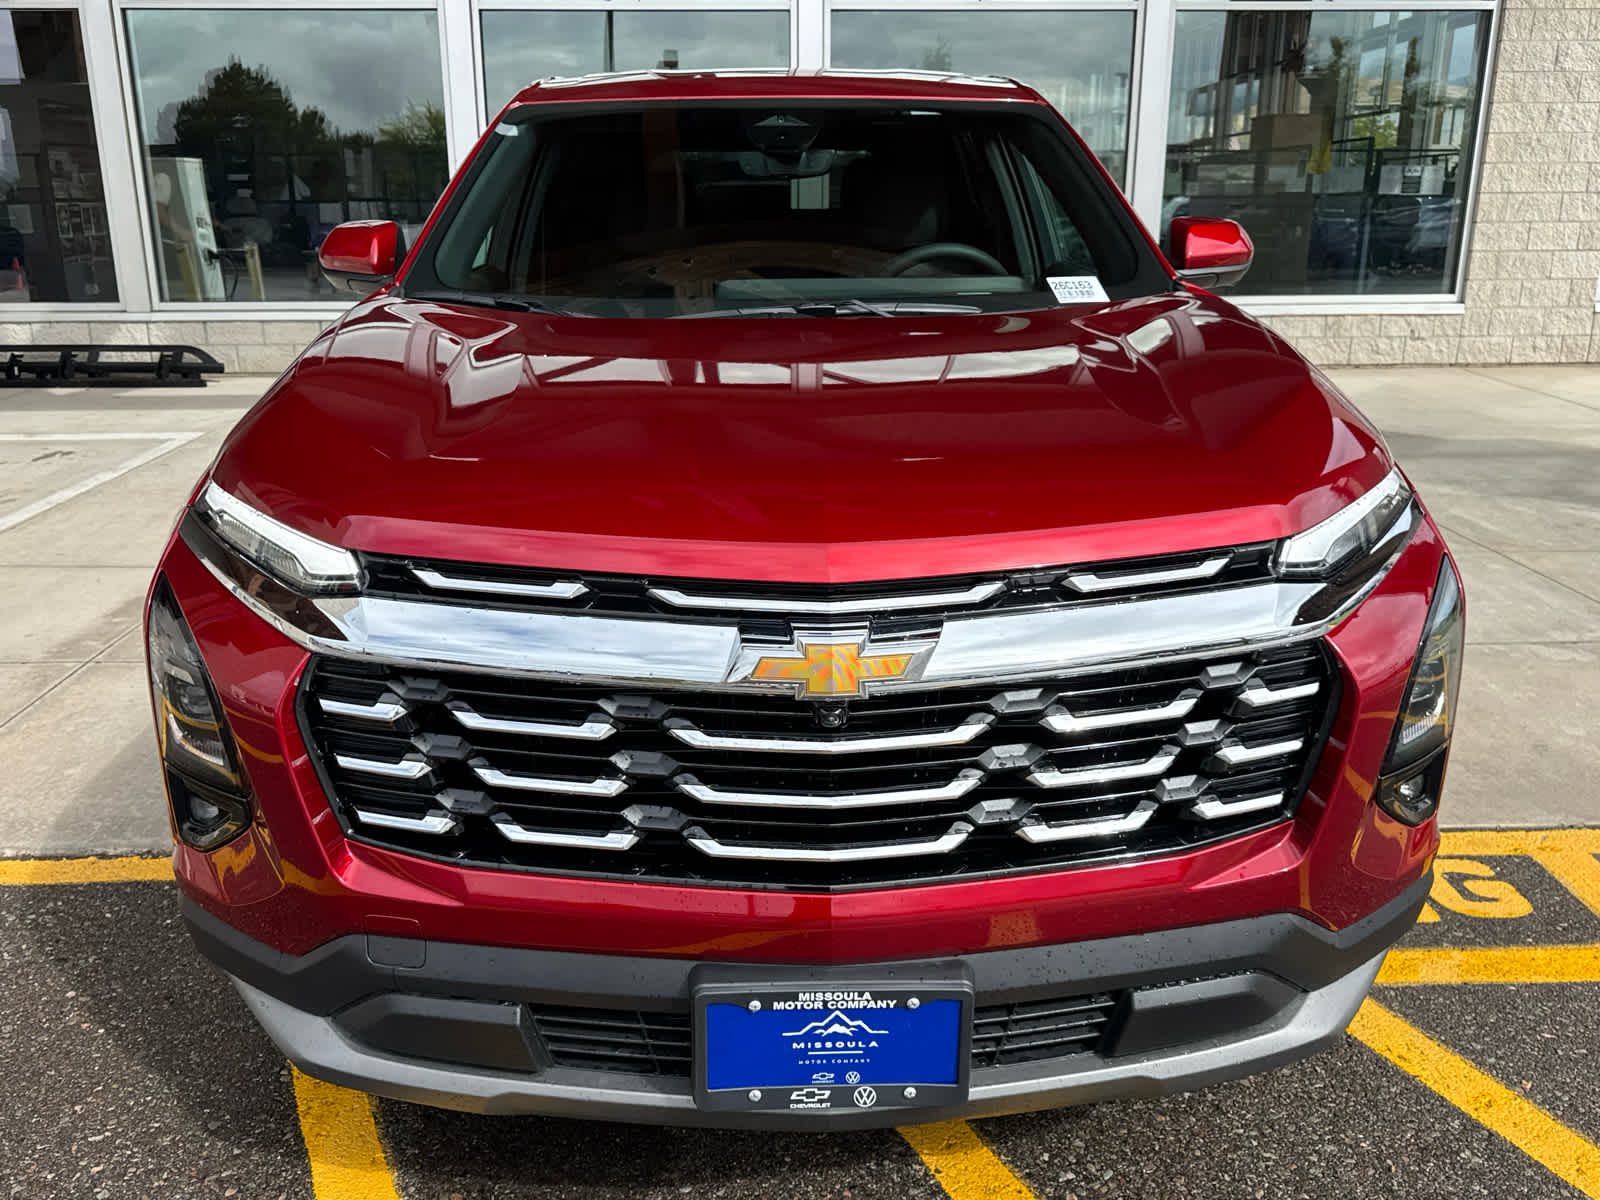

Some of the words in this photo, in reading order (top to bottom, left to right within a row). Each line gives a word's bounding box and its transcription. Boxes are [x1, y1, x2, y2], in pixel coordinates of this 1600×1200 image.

[798, 991, 872, 1002] MISSOULA
[773, 1001, 824, 1010] MOTOR
[827, 1000, 897, 1010] COMPANY
[792, 1041, 879, 1049] MISSOULA
